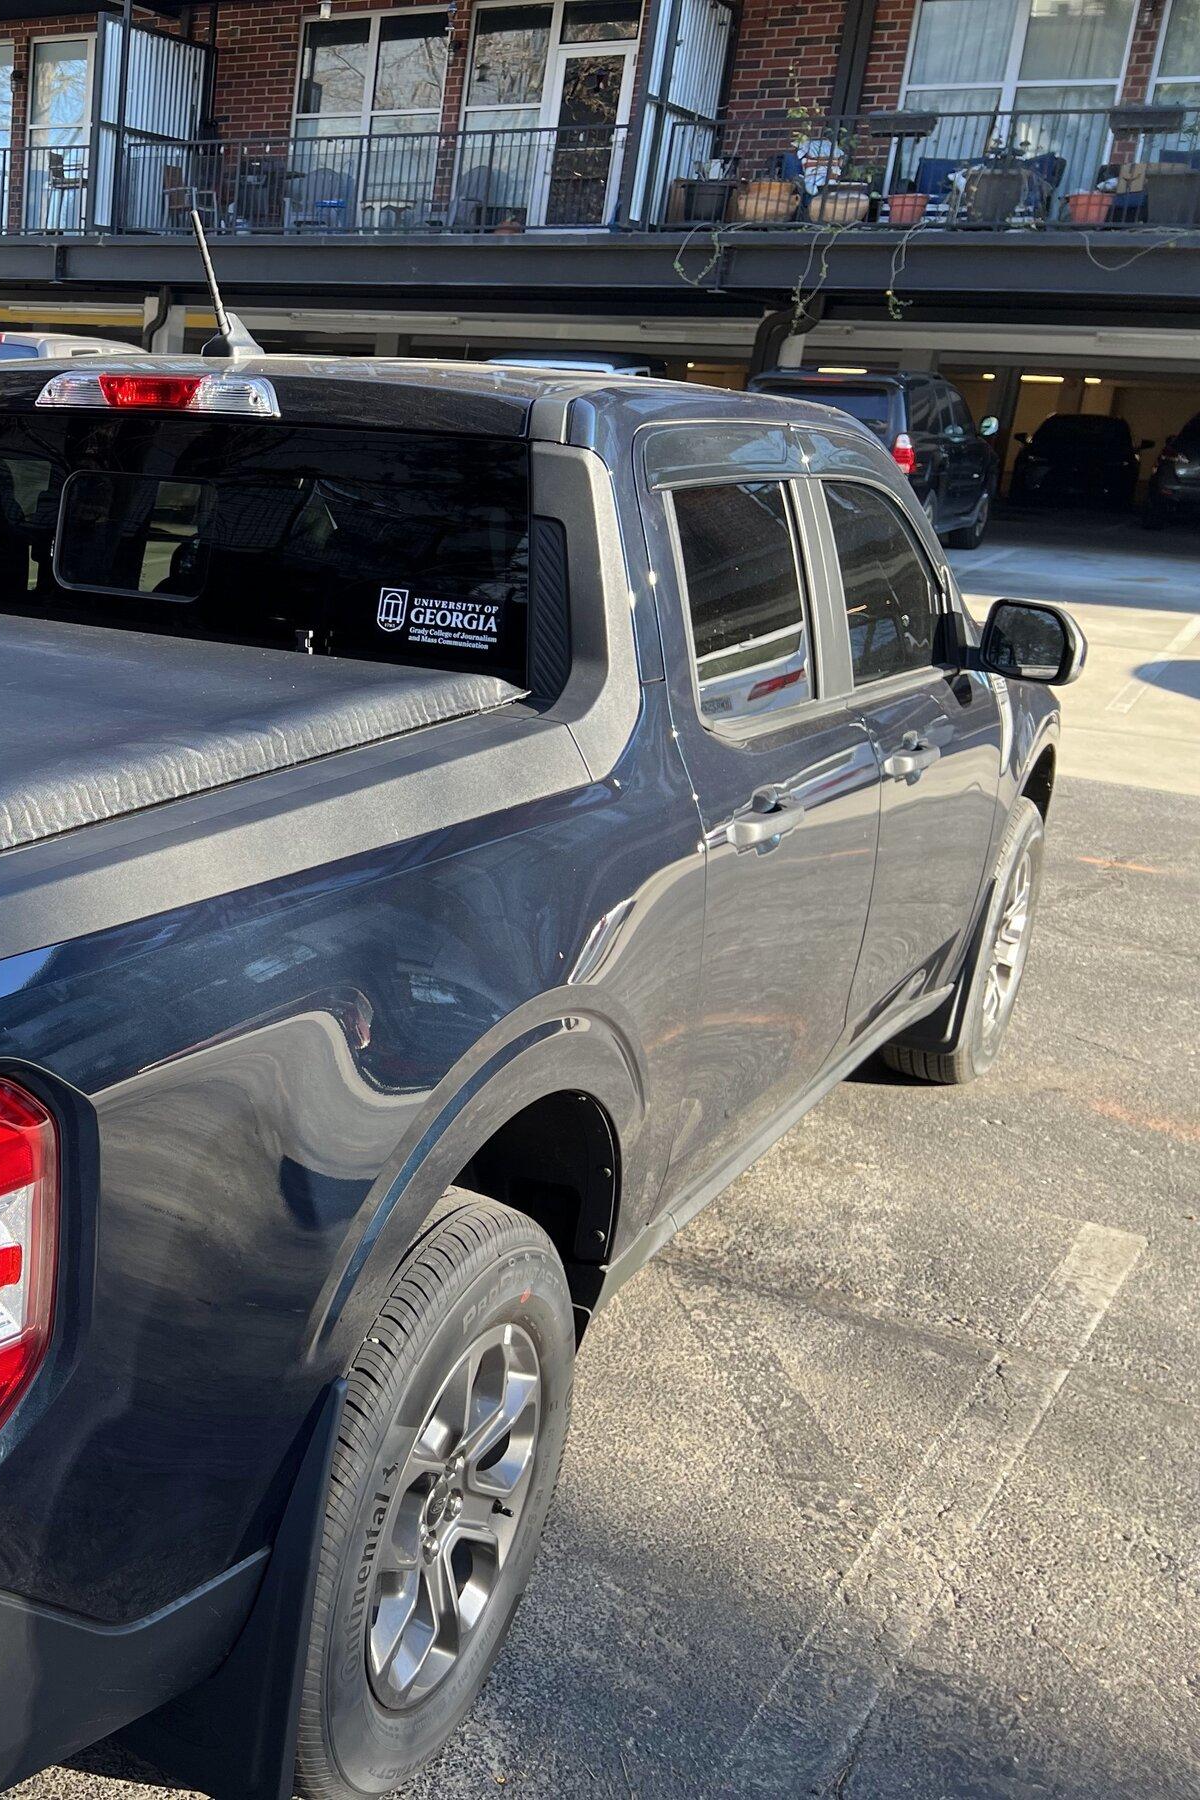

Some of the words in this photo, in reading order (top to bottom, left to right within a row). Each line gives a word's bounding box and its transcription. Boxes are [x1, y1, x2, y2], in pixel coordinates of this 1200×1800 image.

[413, 597, 481, 613] UNIVERSITY
[484, 605, 499, 614] OF
[410, 607, 498, 632] GEORGIA
[409, 626, 429, 635] Grady
[429, 628, 452, 638] College
[453, 631, 461, 639] of
[460, 632, 497, 643] Journalism
[421, 635, 438, 644] Mass
[438, 637, 489, 650] Communication
